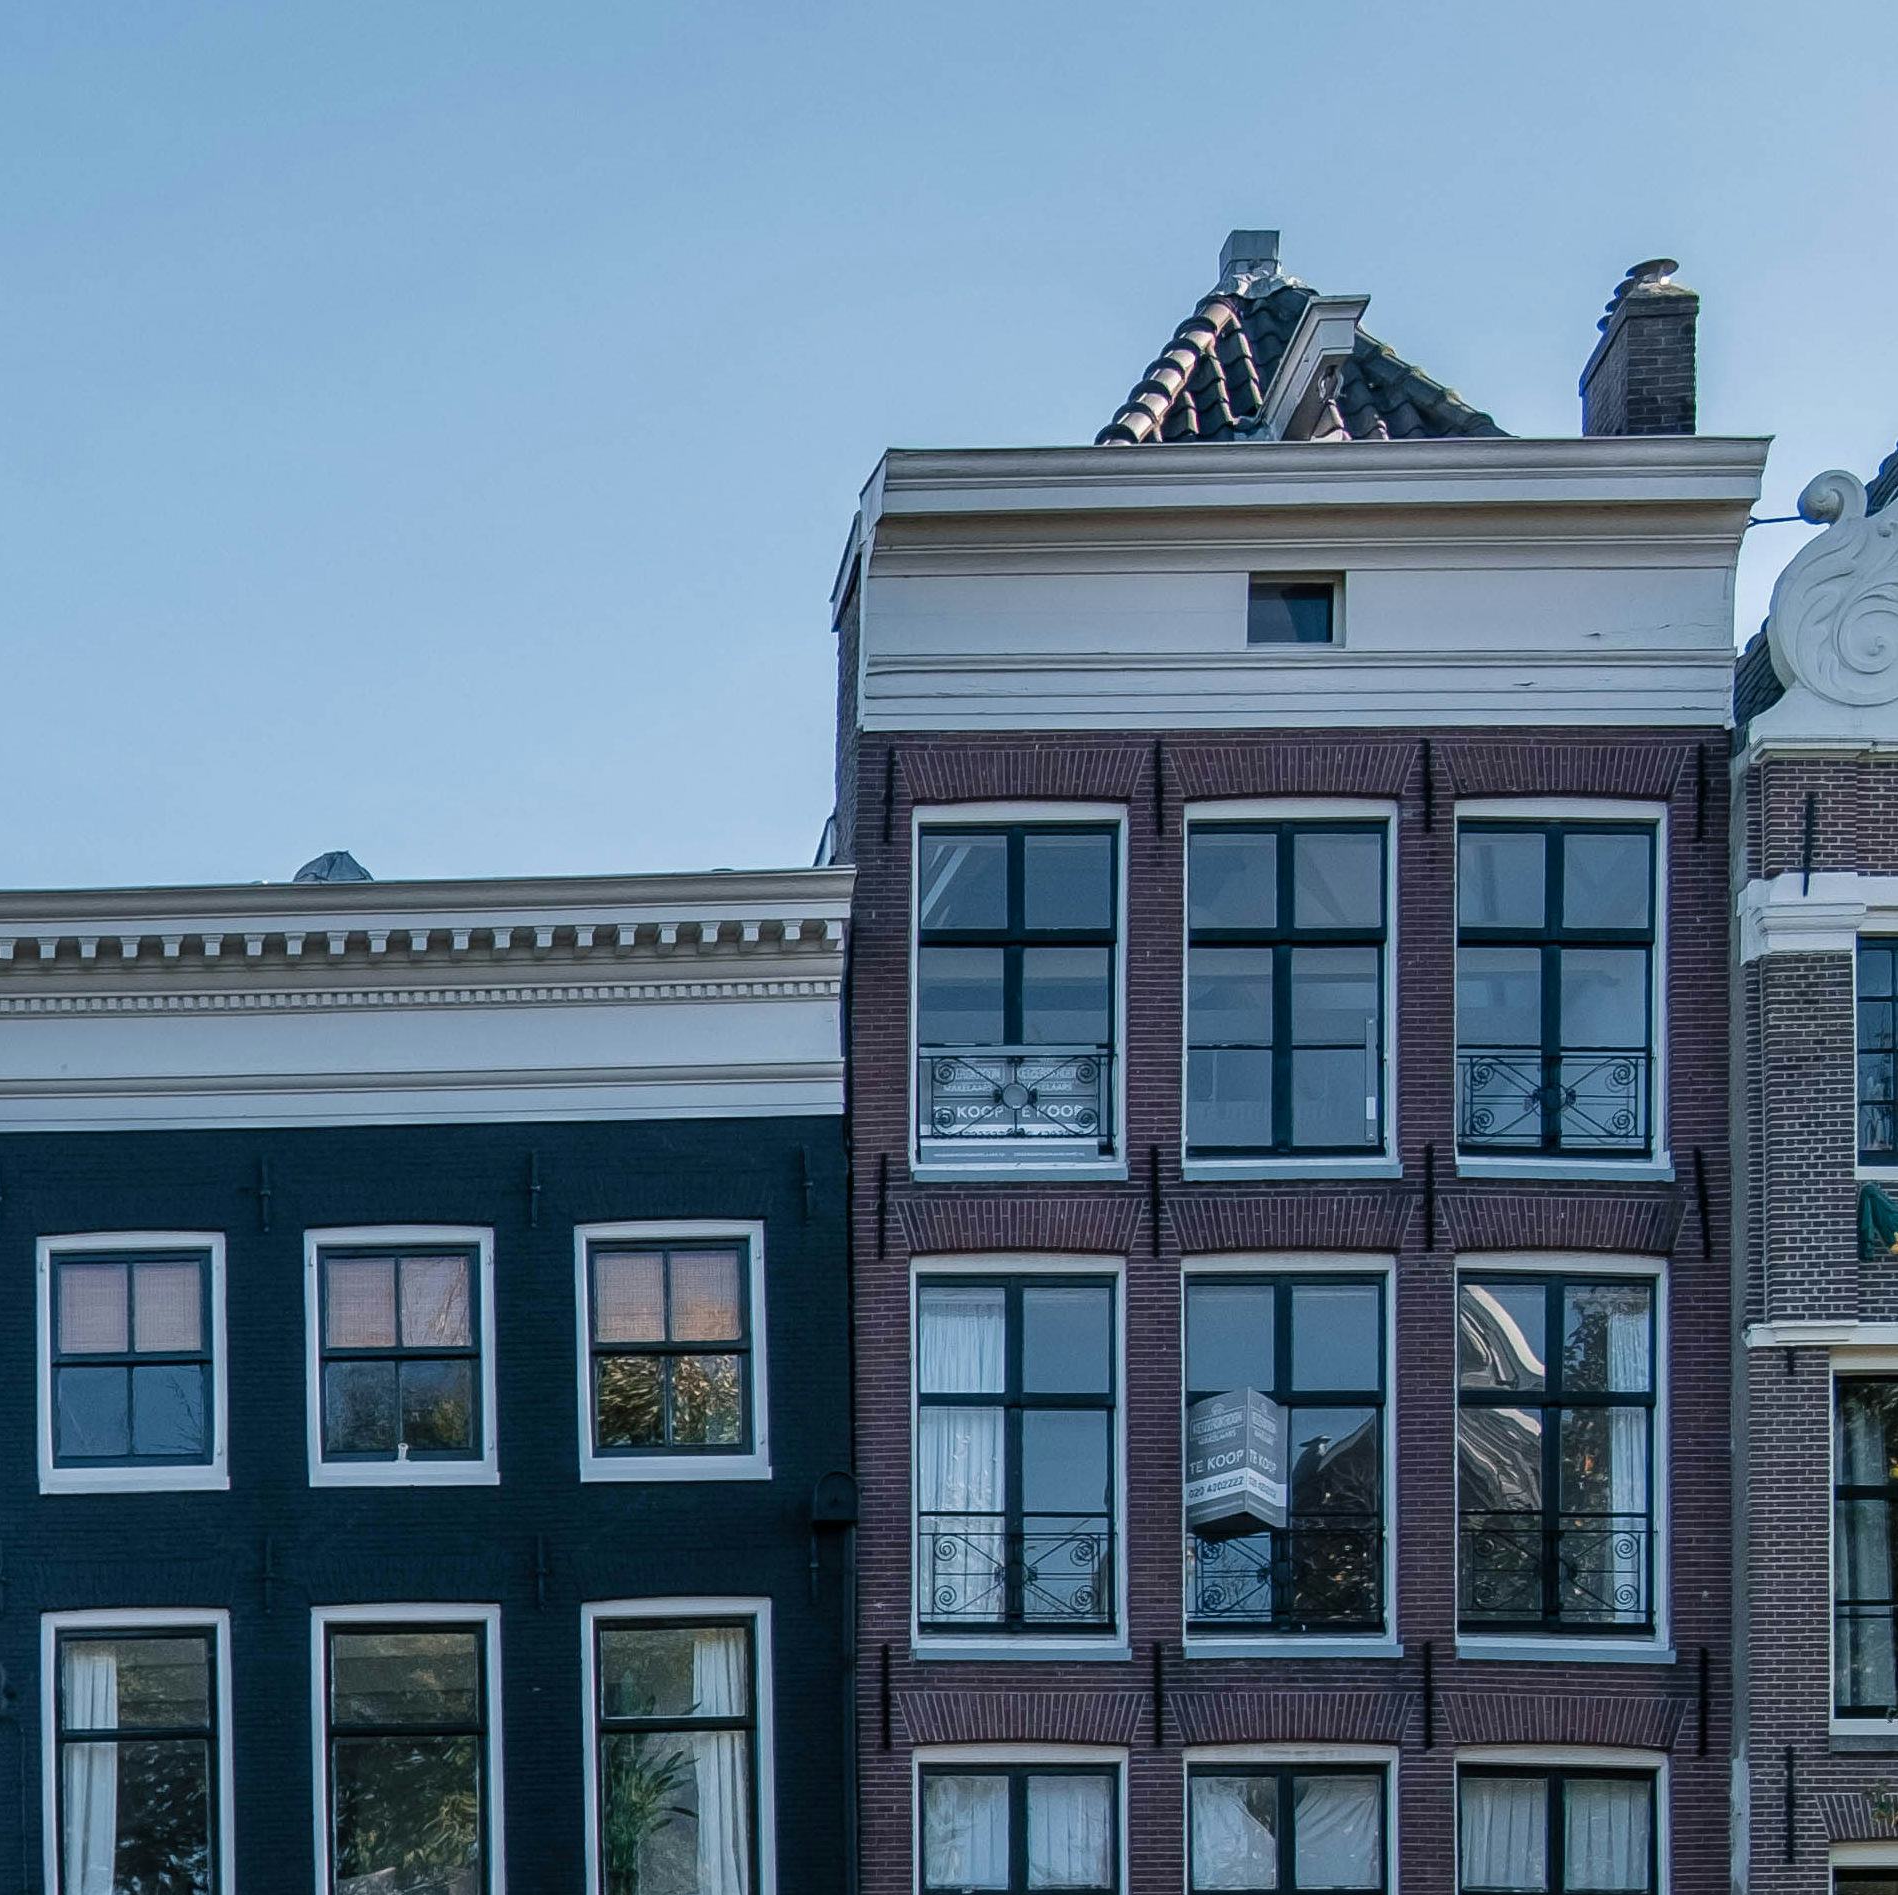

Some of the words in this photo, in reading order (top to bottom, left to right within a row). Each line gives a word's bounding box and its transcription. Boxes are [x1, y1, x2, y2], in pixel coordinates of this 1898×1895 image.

[956, 1105, 1004, 1118] KOOP
[1189, 1460, 1204, 1475] TE
[1207, 1449, 1244, 1472] KOOP
